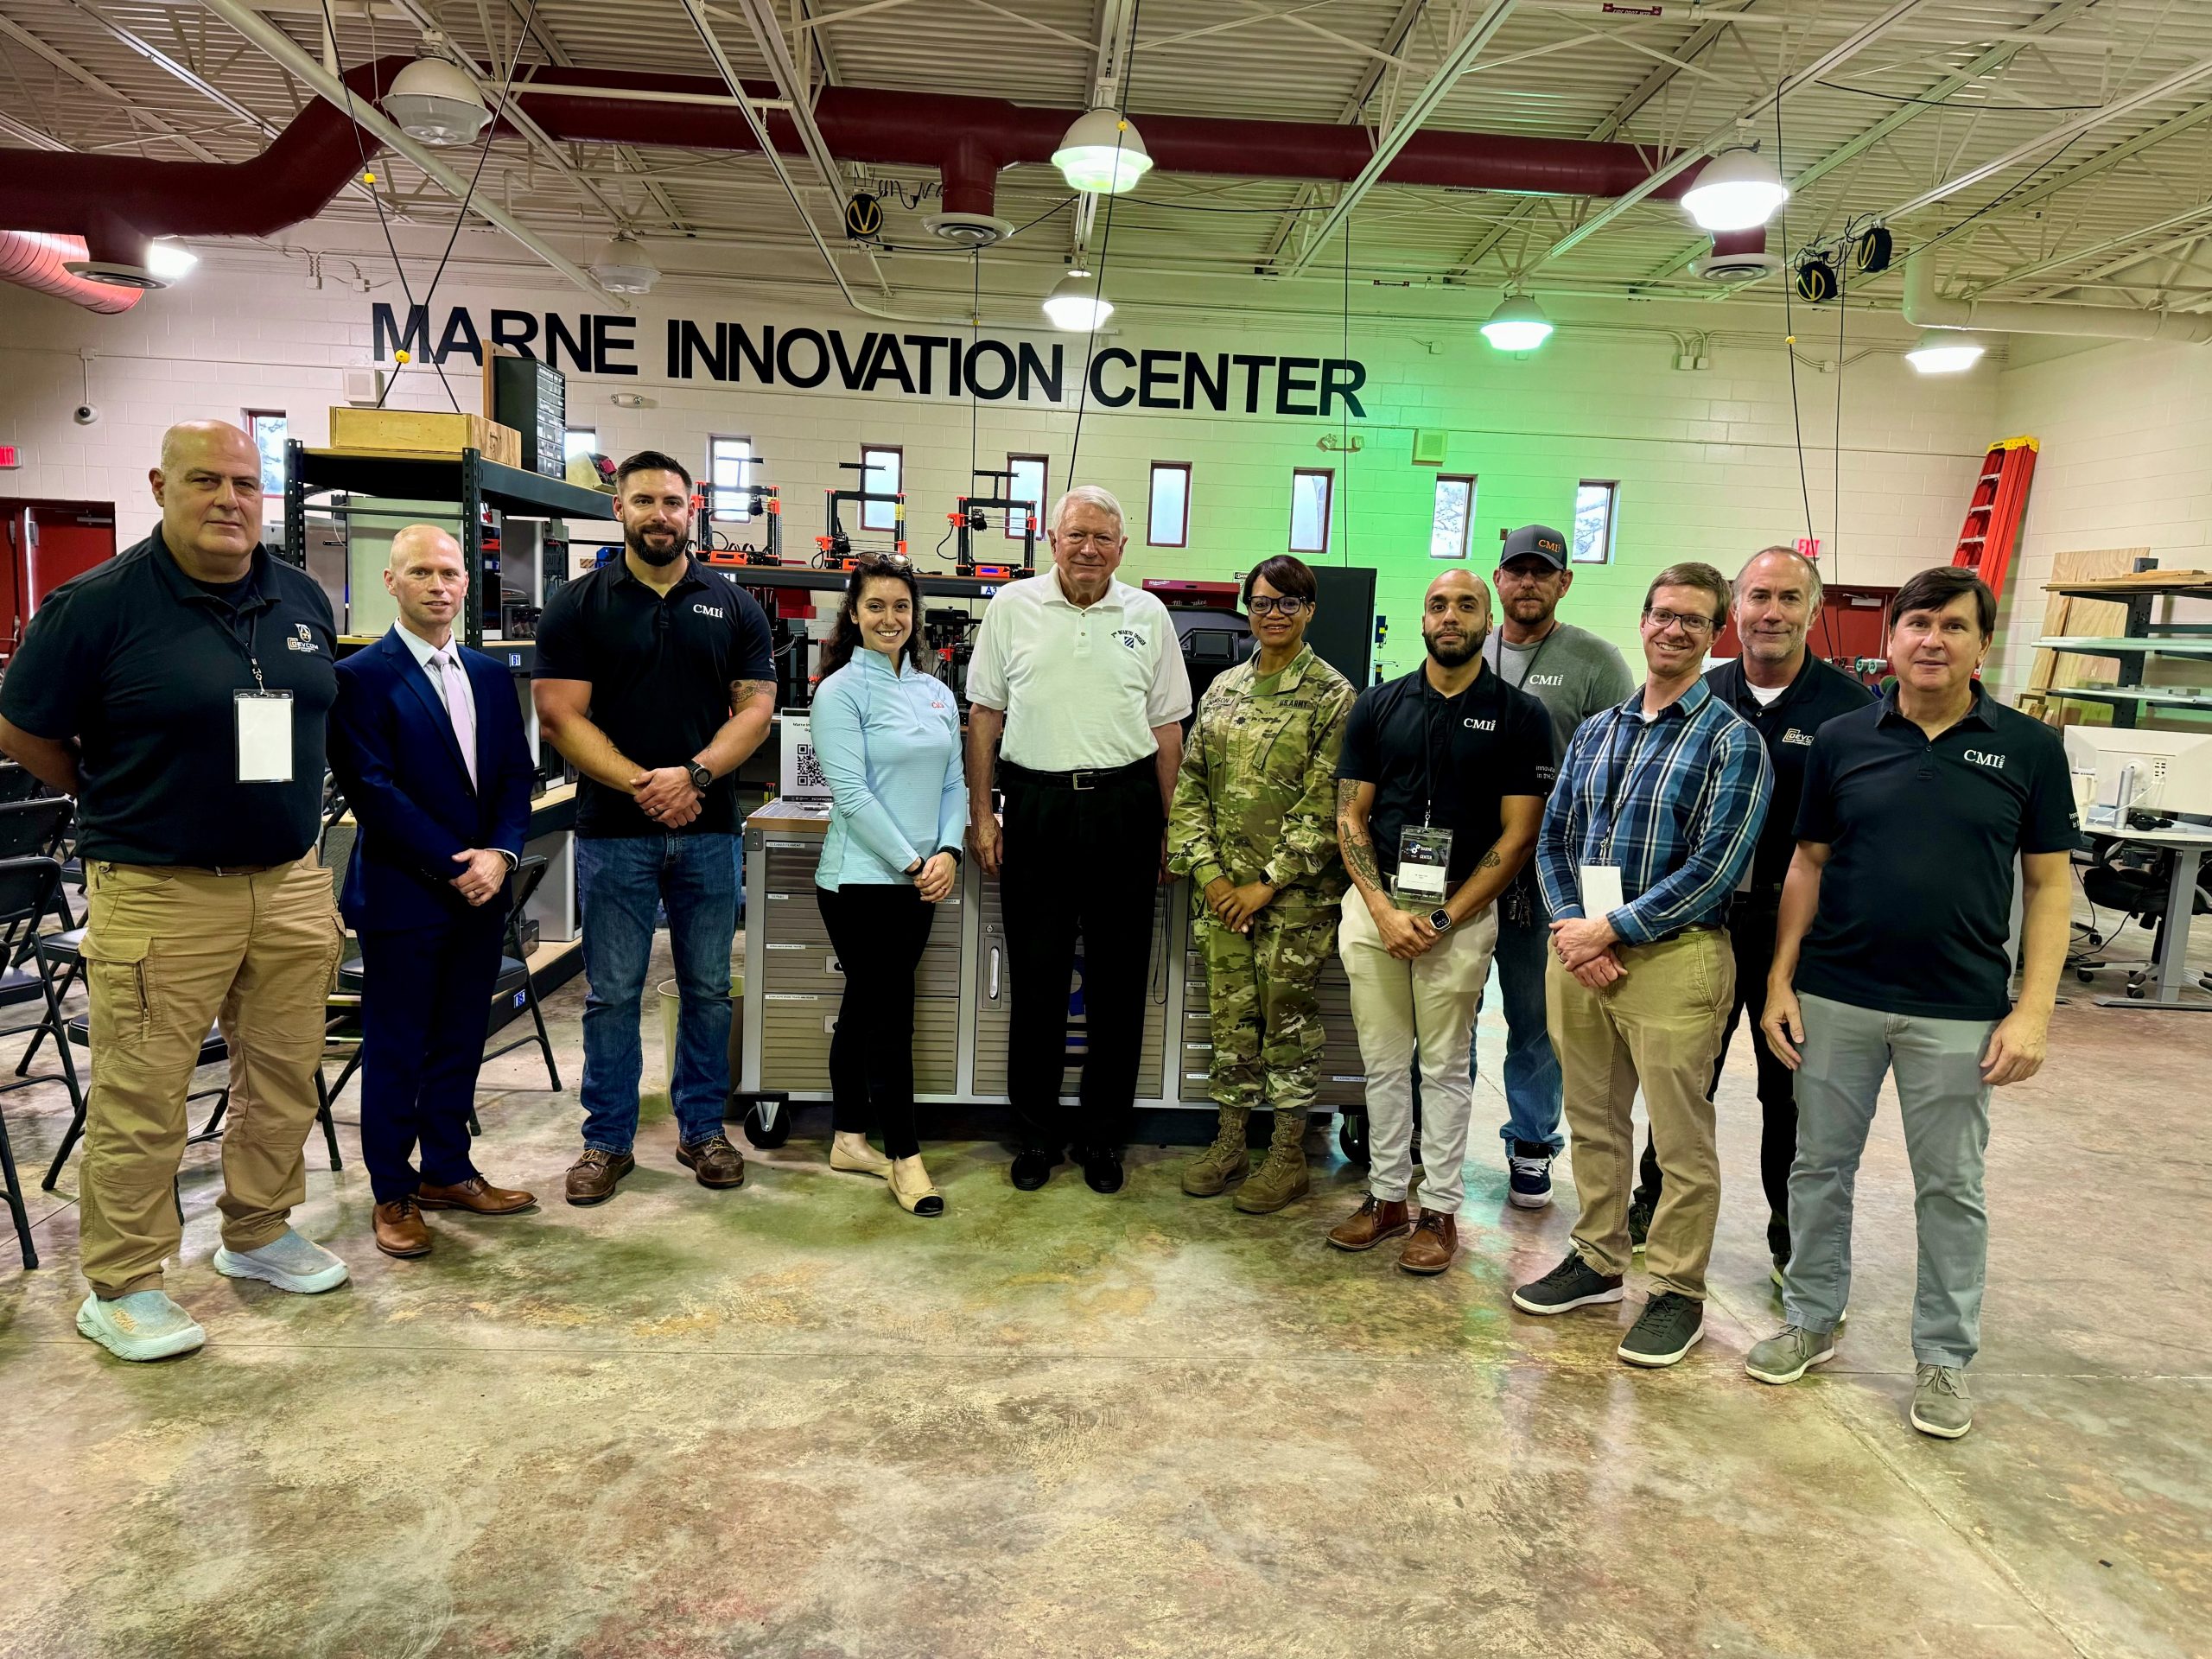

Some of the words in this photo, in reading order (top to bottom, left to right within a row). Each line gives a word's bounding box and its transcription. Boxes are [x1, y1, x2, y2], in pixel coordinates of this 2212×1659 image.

[372, 302, 638, 375] MARNE
[667, 319, 1064, 402] INNOVATION
[1090, 347, 1367, 418] CENTER
